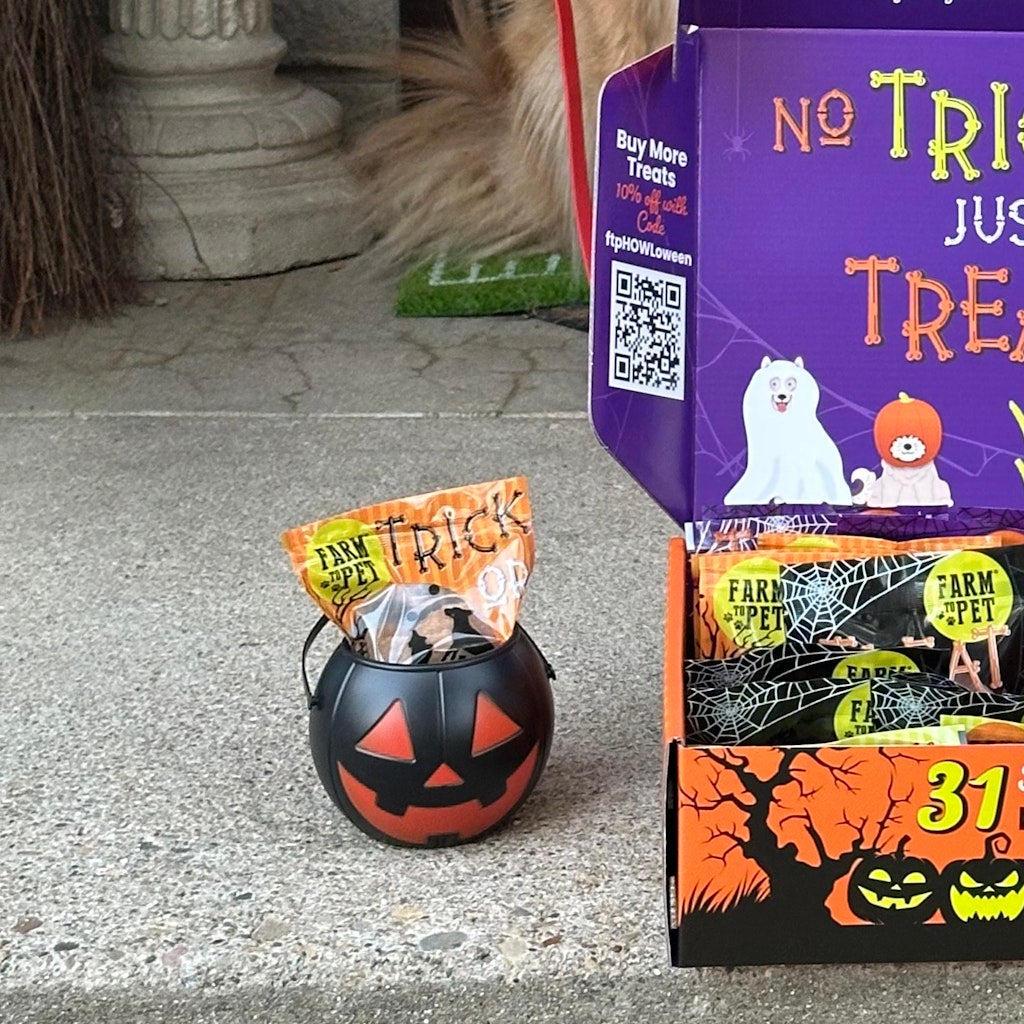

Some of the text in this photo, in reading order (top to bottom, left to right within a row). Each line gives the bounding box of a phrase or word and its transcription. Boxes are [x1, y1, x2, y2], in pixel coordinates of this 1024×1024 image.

[773, 88, 854, 152] NO
[616, 128, 688, 167] Buy More
[627, 156, 677, 188] Treats
[616, 182, 688, 215] 10% off with
[637, 209, 665, 235] Code
[605, 229, 692, 266] ftpHOWLoween
[375, 489, 530, 574] TRICK
[315, 532, 370, 571] FARM
[340, 560, 380, 590] PET
[936, 569, 996, 600] FARM
[745, 605, 786, 631] PET
[944, 597, 996, 625] TO PET
[917, 759, 1008, 834] 31
